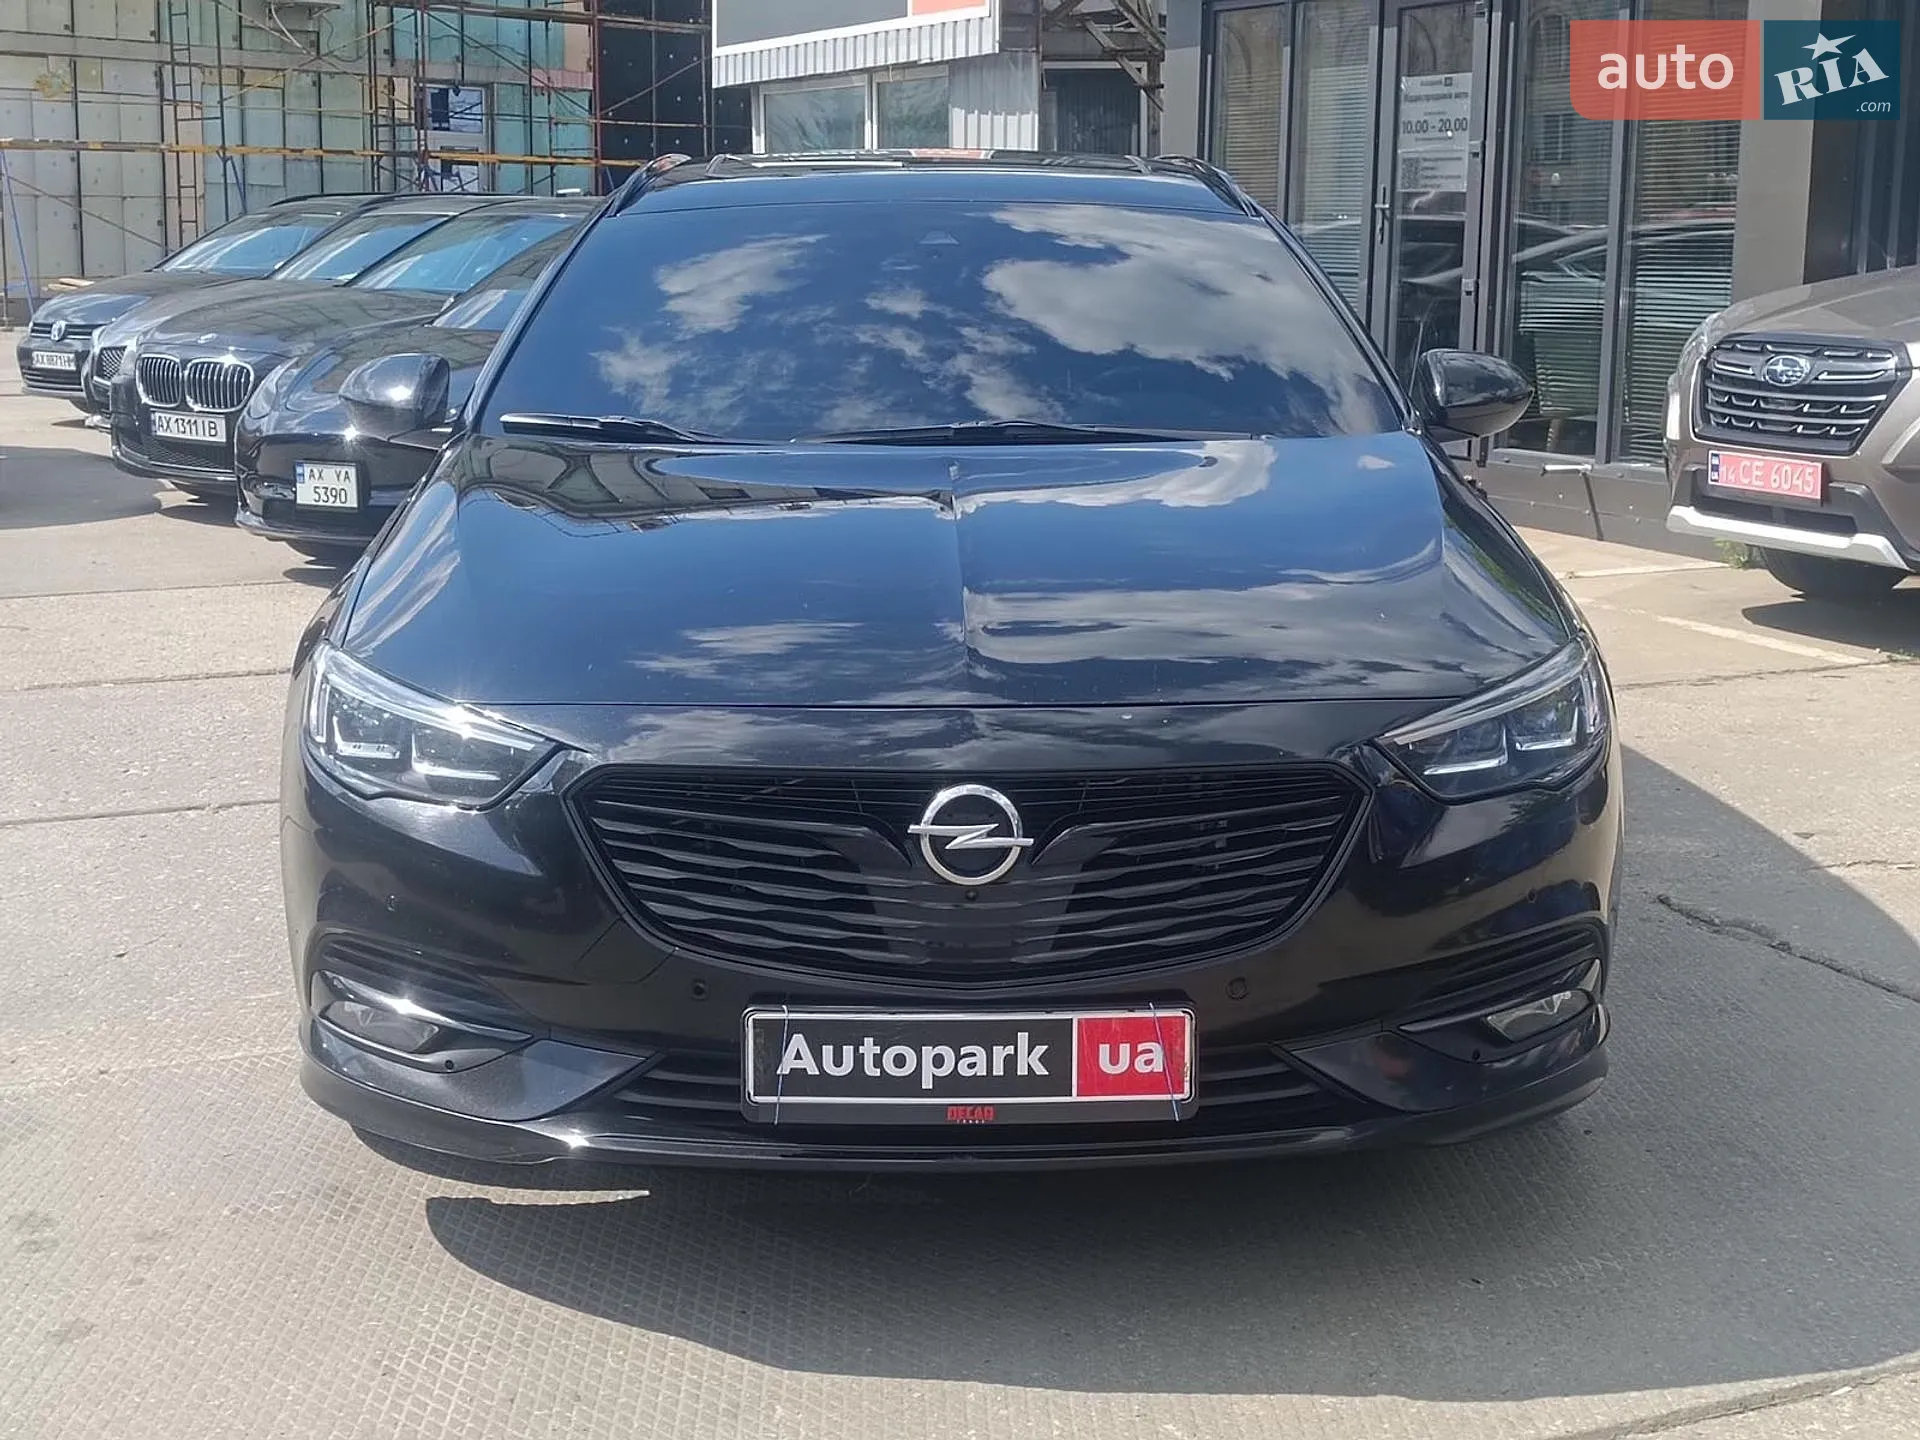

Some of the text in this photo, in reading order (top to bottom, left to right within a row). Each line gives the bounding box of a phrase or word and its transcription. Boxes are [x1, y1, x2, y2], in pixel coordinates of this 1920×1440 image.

[1402, 120, 1429, 134] 10.00
[313, 485, 348, 504] 5390
[777, 1032, 1164, 1090] Autopark ua
